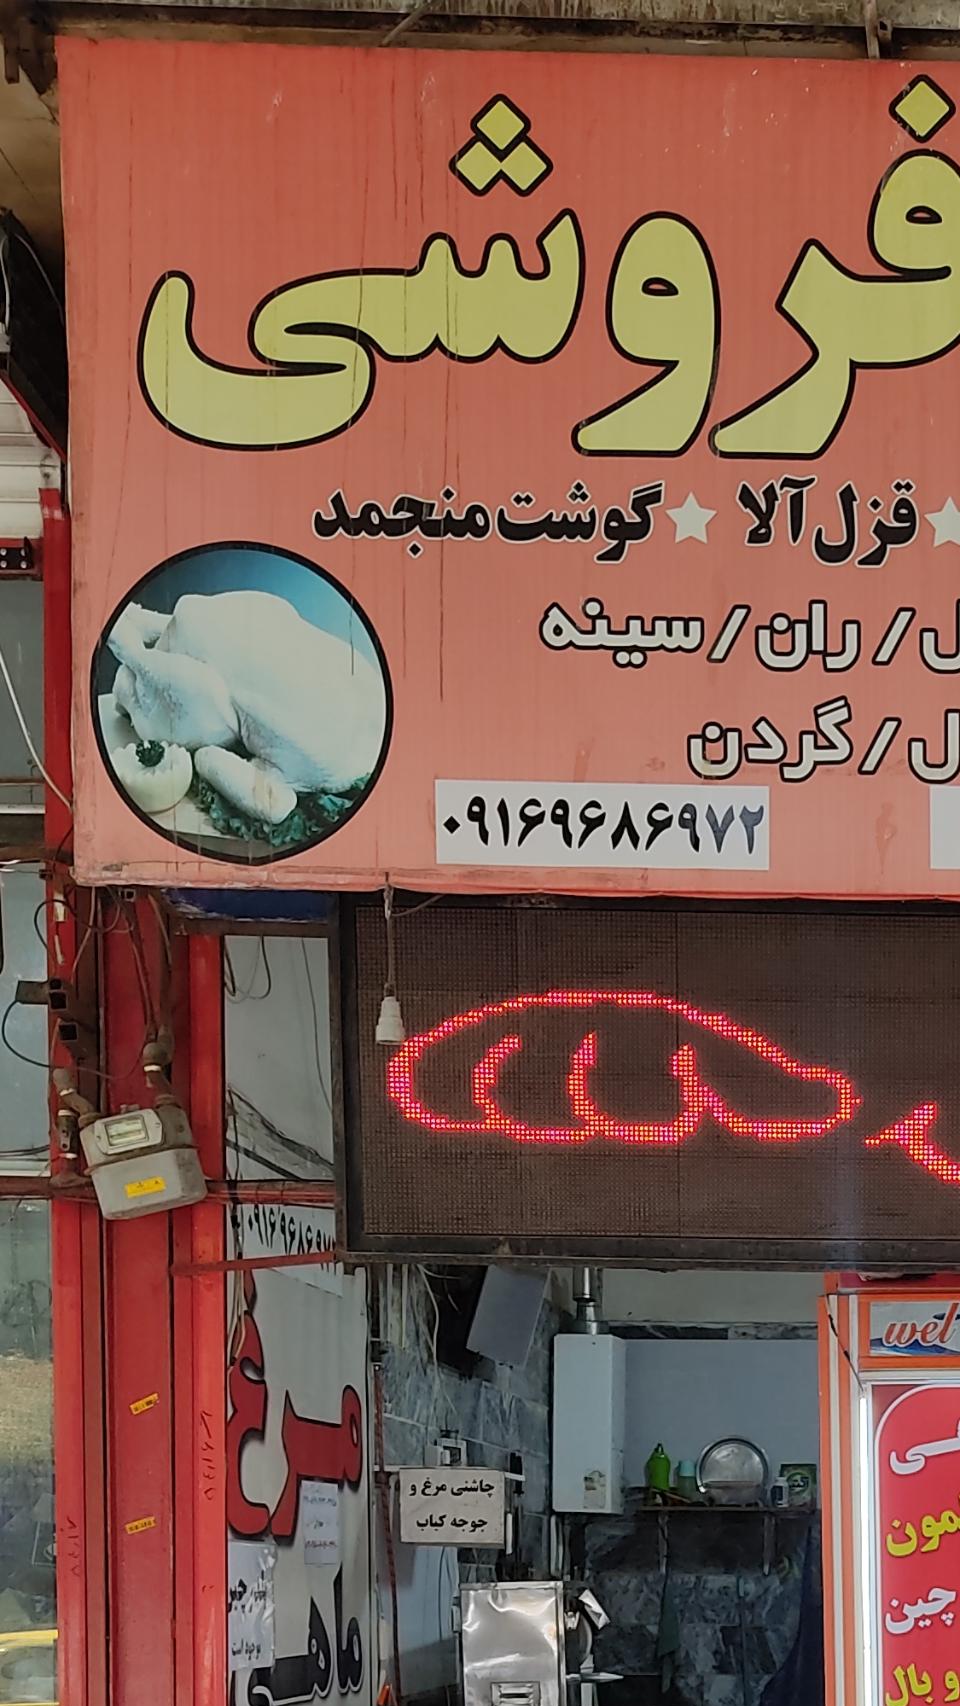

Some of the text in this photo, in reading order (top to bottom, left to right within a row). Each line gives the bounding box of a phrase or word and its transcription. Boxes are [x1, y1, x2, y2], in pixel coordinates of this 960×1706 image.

[312, 480, 663, 565] گوشت منجمد
[736, 477, 920, 570] قزل آلا
[540, 598, 703, 666] سینه
[754, 600, 861, 672] ران
[686, 696, 853, 782] گردن
[441, 796, 767, 853] ۰۹۱۶۹۶۸۶۹۷۲
[882, 1302, 960, 1347] wel
[227, 1267, 363, 1543] مرغ
[408, 1477, 495, 1498] چاشنی مرغ و
[416, 1514, 488, 1532] جوجه کباب
